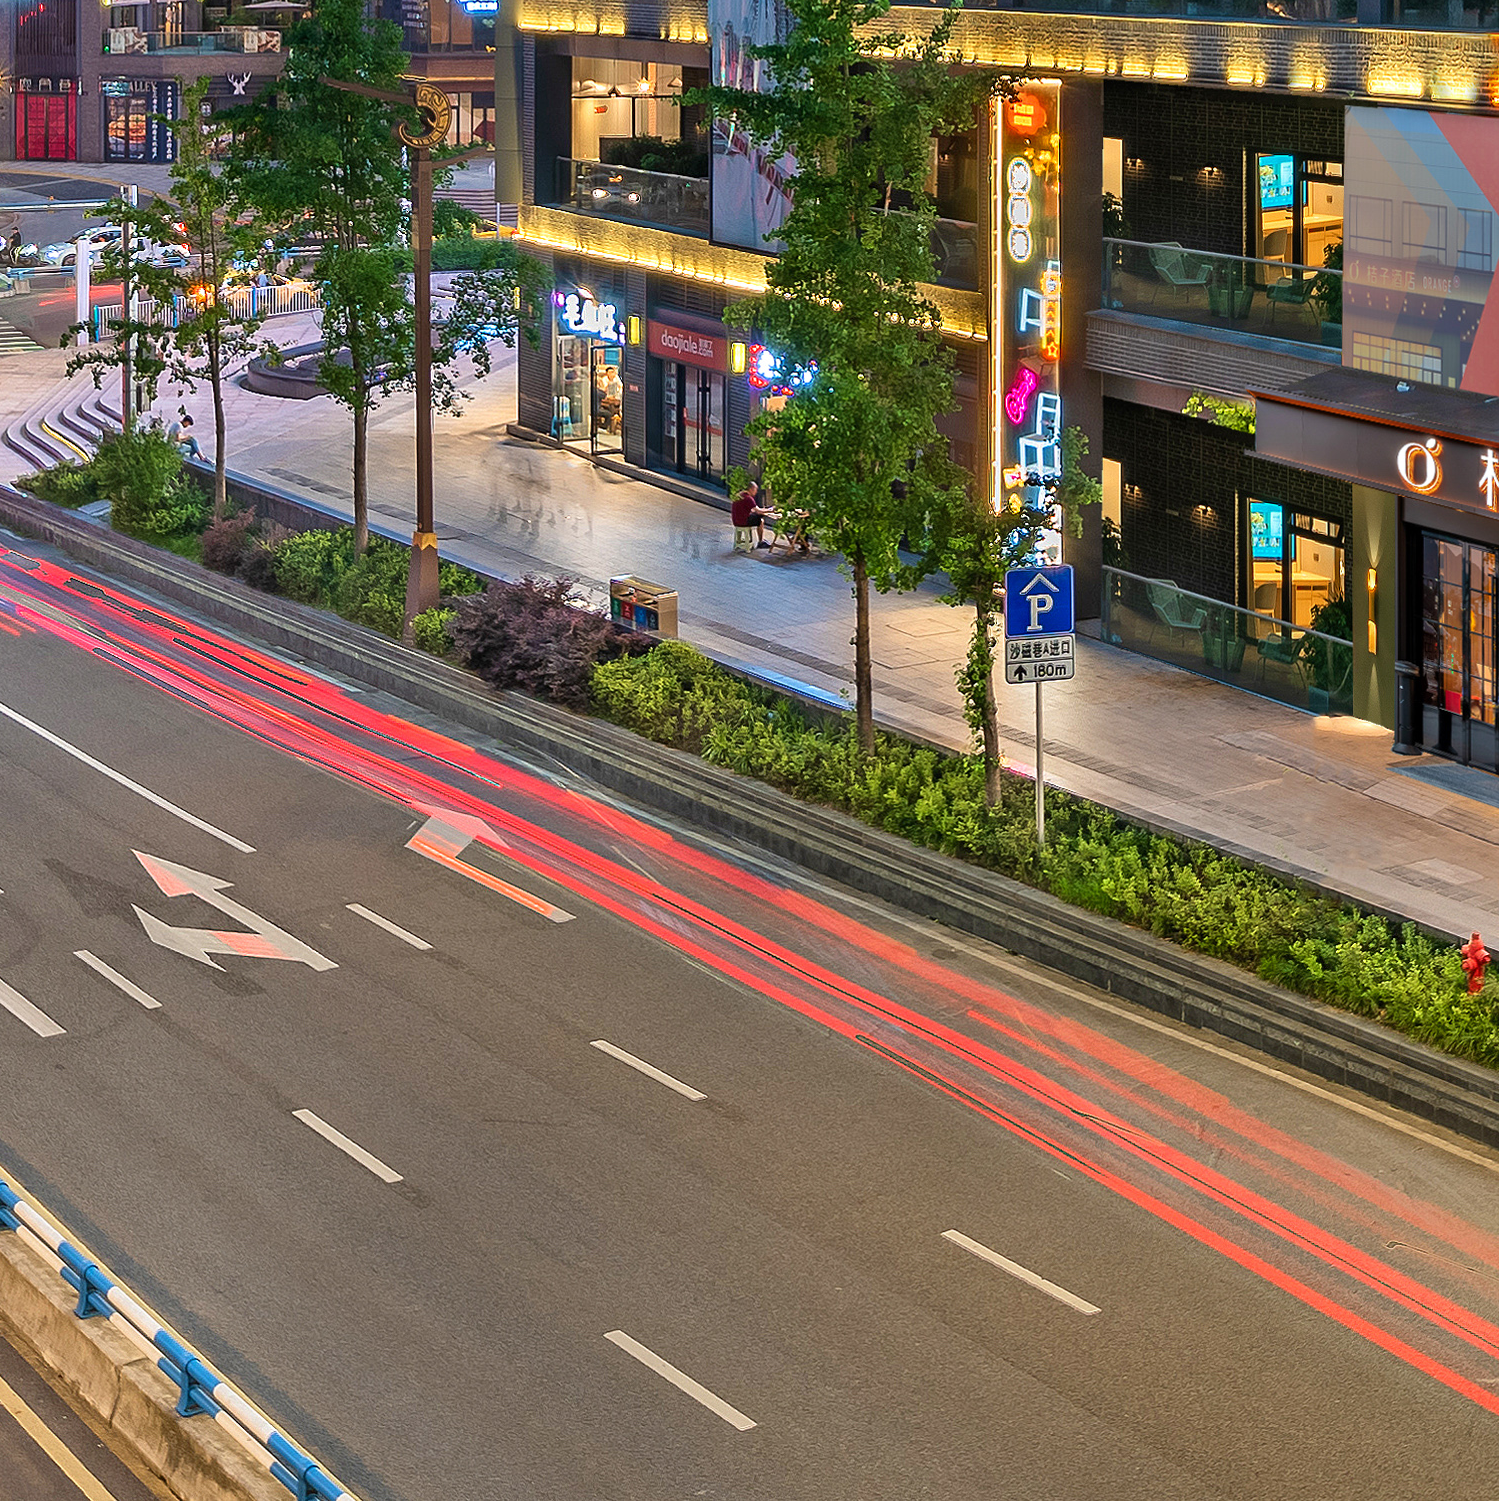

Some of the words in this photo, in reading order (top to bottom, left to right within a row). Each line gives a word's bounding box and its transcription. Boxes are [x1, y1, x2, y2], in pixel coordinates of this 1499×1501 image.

[1366, 264, 1416, 291] 桔子酒店
[1422, 275, 1452, 294] ORANGE
[1026, 593, 1054, 632] P
[1033, 662, 1067, 678] 180m
